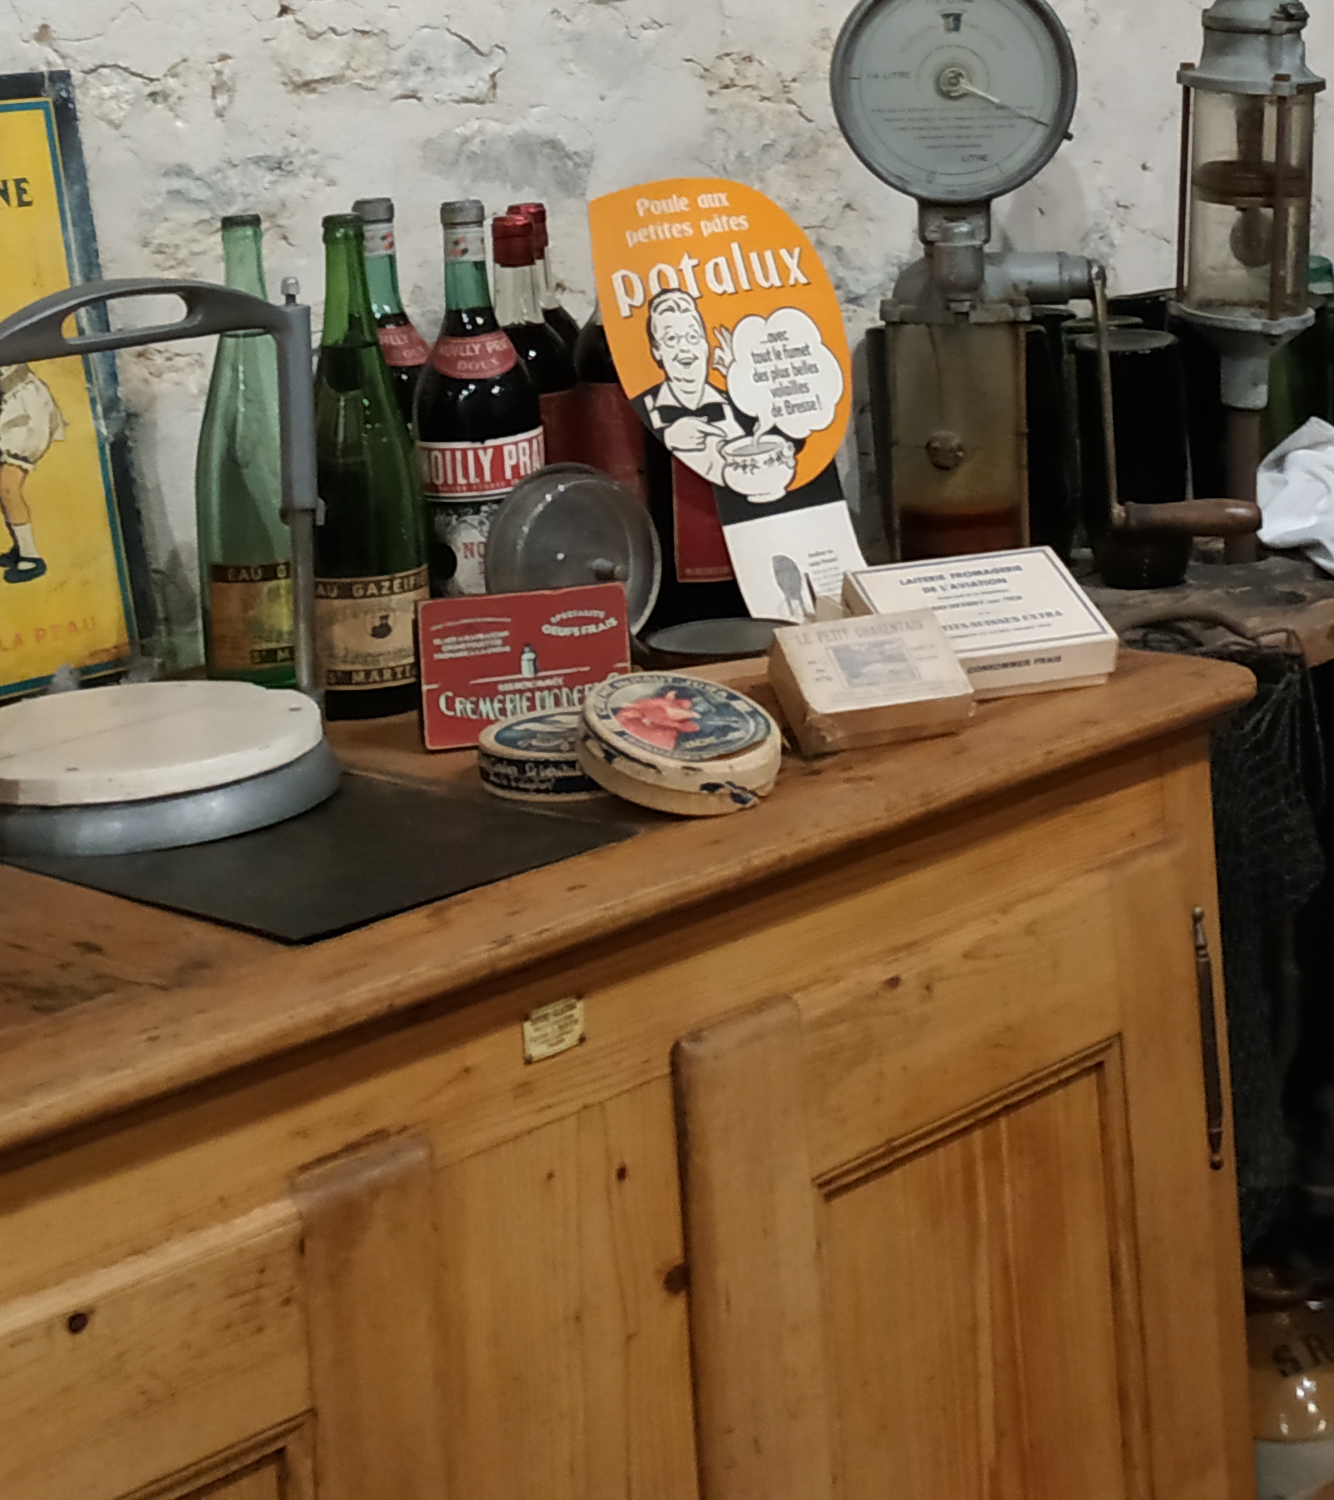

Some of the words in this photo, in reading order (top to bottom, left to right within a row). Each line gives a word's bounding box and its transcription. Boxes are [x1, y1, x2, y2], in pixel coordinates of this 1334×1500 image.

[635, 192, 690, 217] Poule
[696, 190, 731, 208] aux
[624, 221, 694, 248] petites
[699, 213, 750, 237] pâtes
[610, 241, 812, 319] potalux
[750, 348, 773, 365] tout
[772, 345, 783, 361] le
[752, 366, 770, 384] des
[770, 363, 791, 384] plus
[790, 359, 820, 377] belles
[770, 401, 784, 418] de
[227, 568, 264, 582] EAU
[899, 573, 947, 587] LAITERIE
[949, 564, 1024, 581] FROMAGERIE
[314, 584, 340, 599] AU
[921, 585, 938, 595] DE
[940, 576, 1009, 592] L'AVIATION
[34, 615, 97, 644] PEAU
[580, 616, 619, 635] FRAIS
[350, 665, 417, 685] MARTI
